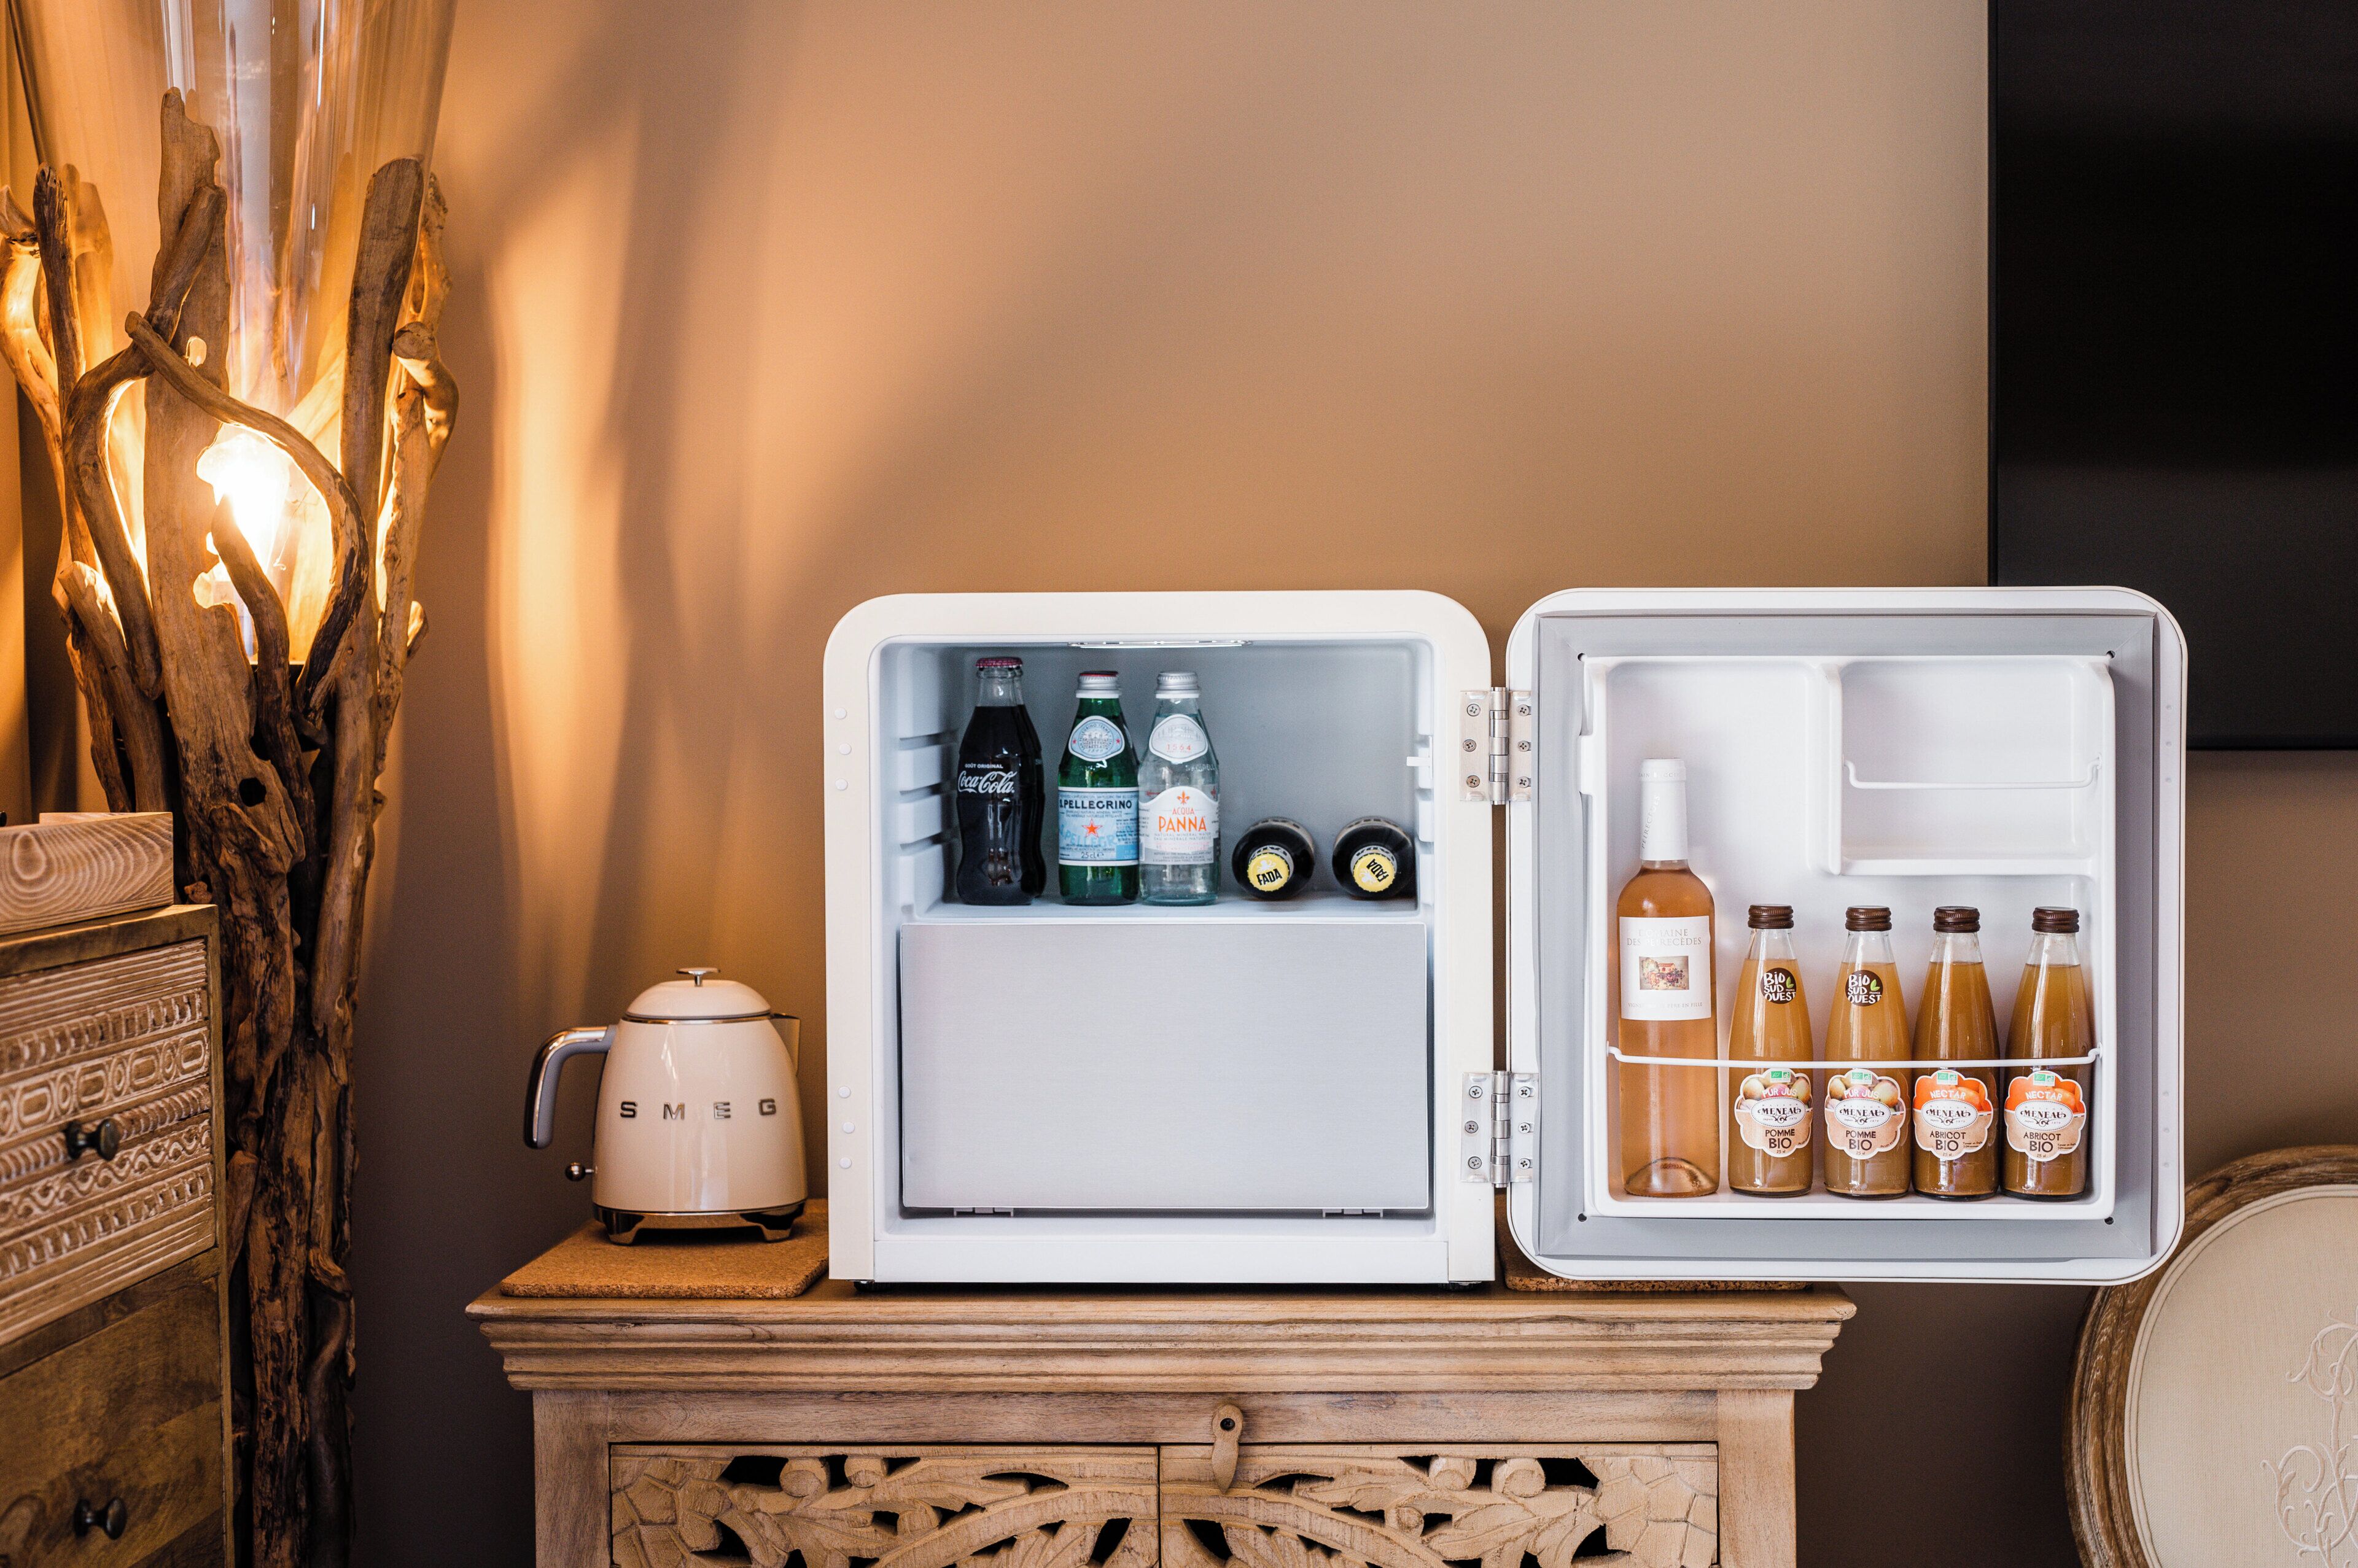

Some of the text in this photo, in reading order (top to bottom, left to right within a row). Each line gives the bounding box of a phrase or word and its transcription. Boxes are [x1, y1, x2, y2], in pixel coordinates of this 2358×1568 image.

[1172, 807, 1195, 815] ACQUA
[1158, 815, 1207, 833] PANNA
[1366, 858, 1390, 883] FADA
[1256, 868, 1283, 886] FADA
[1627, 937, 1641, 946] DES
[1763, 984, 1784, 993] SUD
[1848, 986, 1868, 995] SUD
[1764, 992, 1797, 1002] OUEST
[1848, 995, 1882, 1004] OUEST
[1761, 1087, 1798, 1098] PUR JUS
[1843, 1090, 1880, 1099] PUR JUS
[1929, 1090, 1966, 1100] NECTAR
[2025, 1090, 2063, 1101] NECTAR
[620, 1098, 777, 1120] SMEG
[1839, 1108, 1885, 1117] MENEAU
[1926, 1109, 1971, 1117] MENEAU
[2020, 1109, 2066, 1119] MENEAU
[1765, 1128, 1796, 1137] POMME
[1845, 1130, 1877, 1139] POMME
[1929, 1130, 1966, 1139] ABRICOT
[2023, 1131, 2061, 1141] ABRICOT
[1768, 1137, 1792, 1149] BIO
[1849, 1139, 1872, 1151] BIO
[1936, 1139, 1959, 1152] BIO
[2029, 1140, 2053, 1152] BIO
